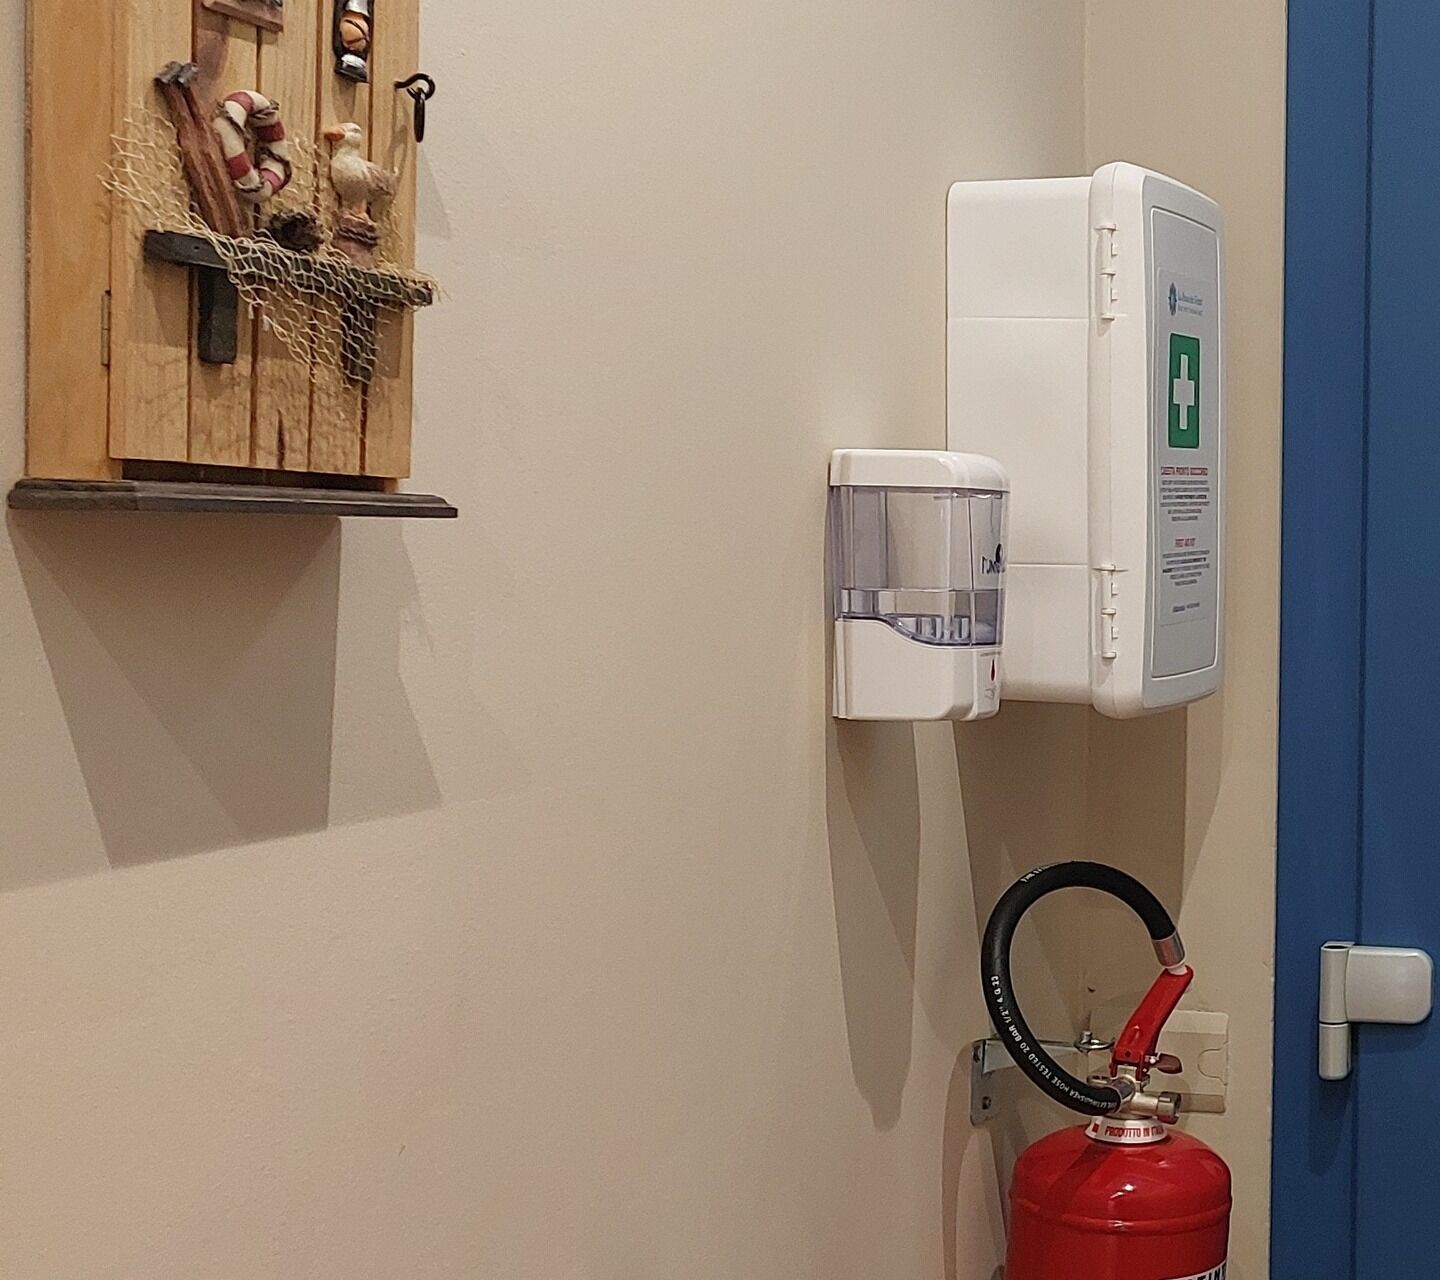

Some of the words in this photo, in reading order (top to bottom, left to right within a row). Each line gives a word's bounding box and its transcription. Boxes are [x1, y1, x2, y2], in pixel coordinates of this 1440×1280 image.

[1008, 1024, 1023, 1042] BAR
[1019, 1042, 1031, 1054] 20
[1028, 1053, 1053, 1080] TESTED
[1051, 1076, 1070, 1093] HOSE
[1105, 1125, 1141, 1138] PRODOTTO
